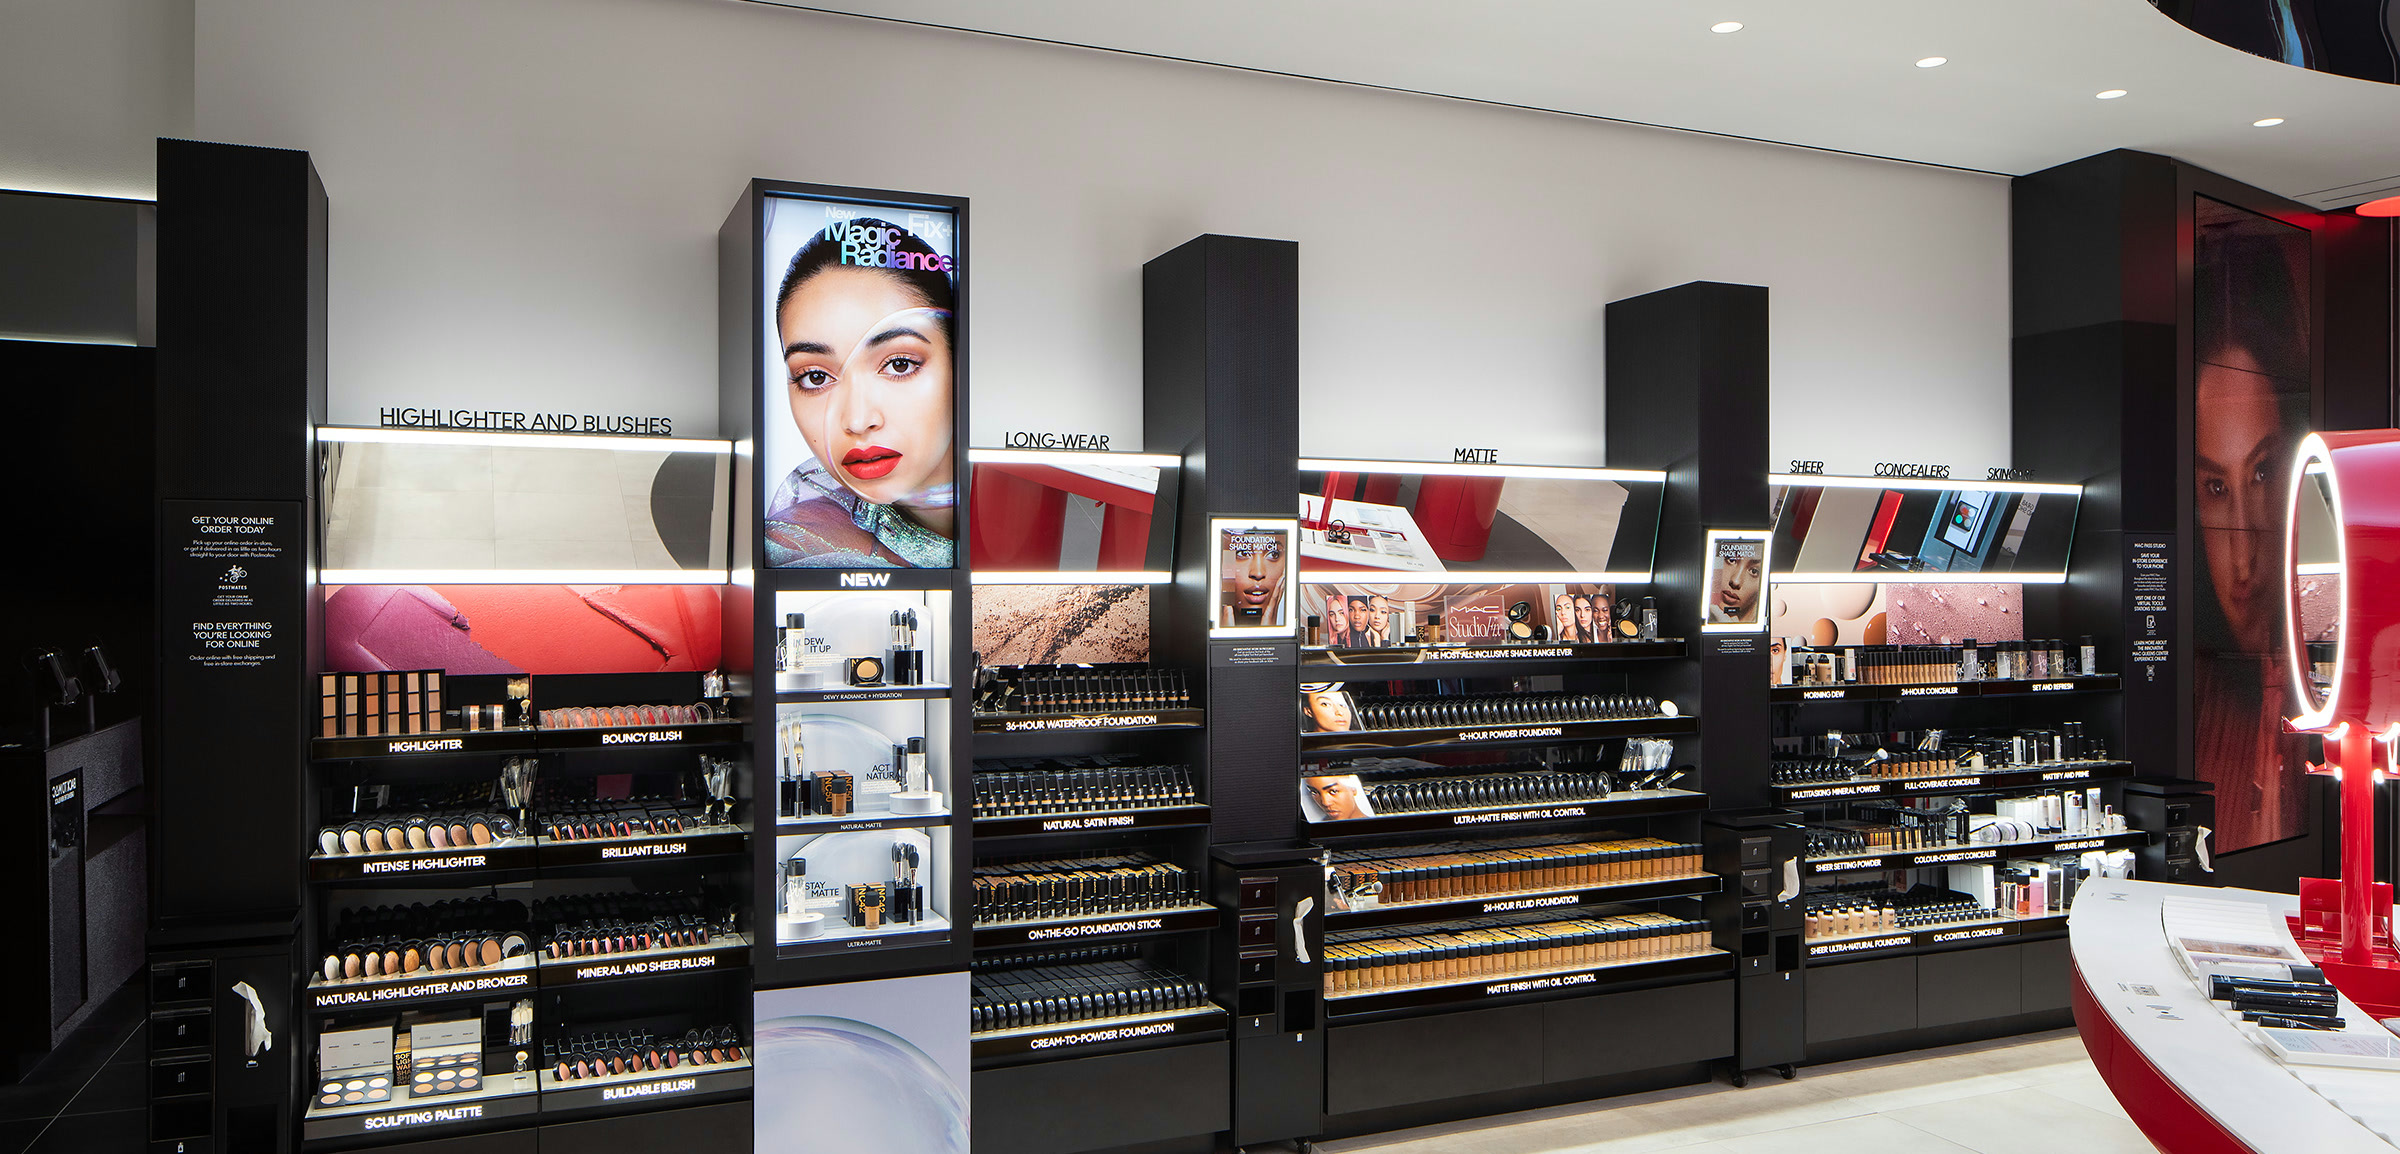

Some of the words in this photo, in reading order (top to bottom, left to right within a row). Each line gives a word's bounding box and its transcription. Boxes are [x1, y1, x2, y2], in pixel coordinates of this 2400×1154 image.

[825, 206, 855, 219] New
[825, 218, 901, 250] Magic
[841, 241, 953, 272] Radiance
[381, 407, 526, 430] HIGHLIGHTER
[531, 413, 577, 432] AND
[584, 415, 671, 435] BLUSHES
[1005, 431, 1110, 450] LONG-WEAR
[1454, 447, 1498, 463] MATTE
[1790, 460, 1824, 475] SHEER
[1874, 462, 1950, 478] CONCEALERS
[192, 516, 210, 524] GET
[241, 517, 274, 525] ONLINE
[1229, 543, 1251, 551] SHADE
[1253, 543, 1277, 551] MATCH
[840, 573, 891, 587] NEW
[193, 622, 214, 630] FIND
[216, 622, 272, 630] EVERYTHING
[193, 631, 227, 639] YOU'RE
[230, 631, 272, 639] LOOKING
[804, 637, 824, 646] DEW
[206, 640, 224, 648] FOR
[226, 640, 260, 648] ONLINE
[810, 645, 817, 653] IT
[819, 645, 831, 653] UP
[1426, 650, 1440, 660] THE
[1440, 650, 1459, 660] MOST
[1460, 649, 1509, 659] ALL-INCLUSIVE
[1510, 649, 1532, 658] SHADE
[1533, 649, 1556, 658] RANGE
[1556, 648, 1573, 657] EVER
[1804, 691, 1831, 699] MORNING
[1831, 690, 1845, 699] DEW
[1901, 688, 1925, 696] 24-HOUR
[1926, 687, 1958, 695] CONCEALER
[1006, 720, 1045, 731] 36-HOUR
[1046, 717, 1104, 730] WATERPROOF
[1105, 715, 1157, 727] FOUNDATION
[602, 732, 649, 744] BOUNCY
[650, 731, 682, 742] BLUSH
[1459, 731, 1488, 740] 12-HOUR
[1489, 730, 1518, 739] POWDER
[1519, 728, 1561, 738] FOUNDATION
[389, 739, 462, 752] HIGHLIGHTER
[872, 763, 890, 772] ACT
[2042, 772, 2063, 780] MATTIFY
[2064, 771, 2075, 779] AND
[2075, 770, 2089, 778] PRIME
[1904, 780, 1948, 790] FULL-COVERAGE
[1948, 778, 1980, 788] CONCEALER
[1791, 789, 1831, 799] MULTITASKING
[1832, 787, 1856, 796] MINERAL
[1856, 785, 1880, 794] POWDER
[1453, 813, 1500, 824] ULTRA-MATTE
[1500, 812, 1522, 822] FINISH
[1522, 811, 1540, 820] WITH
[1541, 810, 1552, 819] OIL
[1553, 807, 1586, 818] CONTROL
[1043, 819, 1082, 831] NATURAL
[1083, 817, 1107, 828] SATIN
[1108, 816, 1134, 827] FINISH
[602, 846, 652, 858] BRILLIANT
[654, 843, 686, 855] BLUSH
[2055, 842, 2077, 851] HYDRATE
[2078, 841, 2088, 850] AND
[2089, 840, 2104, 849] GLOW
[1914, 852, 1964, 864] COLOUR-CORRECT
[1964, 850, 1996, 860] CONCEALER
[364, 861, 410, 873] INTENSE
[412, 856, 486, 870] HIGHLIGHTER
[1816, 863, 1834, 872] SHEER
[1834, 861, 1856, 871] SETTING
[1856, 859, 1881, 868] POWDER
[805, 881, 826, 890] STAY
[811, 888, 839, 897] MATTE
[1483, 901, 1515, 912] 24-HOUR
[1516, 899, 1534, 909] FLUID
[1535, 895, 1579, 907] FOUNDATION
[1028, 927, 1079, 940] ON-THE-GO
[1080, 921, 1135, 935] FOUNDATION
[1137, 919, 1161, 930] STICK
[1933, 931, 1971, 942] OIL-CONTROL
[1971, 928, 2003, 938] CONCEALER
[847, 940, 882, 948] ULTRA-MATTE
[1810, 946, 1828, 955] SHEER
[1829, 941, 1874, 953] ULTRA-NATURAL
[1874, 937, 1911, 948] FOUNDATION
[577, 966, 623, 979] MINERAL
[624, 963, 648, 975] AND
[649, 960, 681, 973] SHEER
[681, 956, 715, 969] BLUSH
[316, 991, 371, 1006] NATURAL
[373, 983, 449, 1001] HIGHLIGHTER
[450, 980, 475, 993] AND
[477, 975, 528, 991] BRONZER
[1487, 984, 1509, 995] MATTE
[1510, 981, 1531, 992] FINISH
[1532, 979, 1549, 990] WITH
[1550, 978, 1562, 987] OIL
[1563, 974, 1596, 985] CONTROL
[1030, 1030, 1118, 1049] CREAM-TO-POWDER
[1119, 1023, 1174, 1038] FOUNDATION
[603, 1083, 660, 1100] BUILDABLE
[661, 1079, 695, 1094] BLUSH
[365, 1111, 433, 1130] SCULPTING
[435, 1105, 482, 1122] PALETTE
